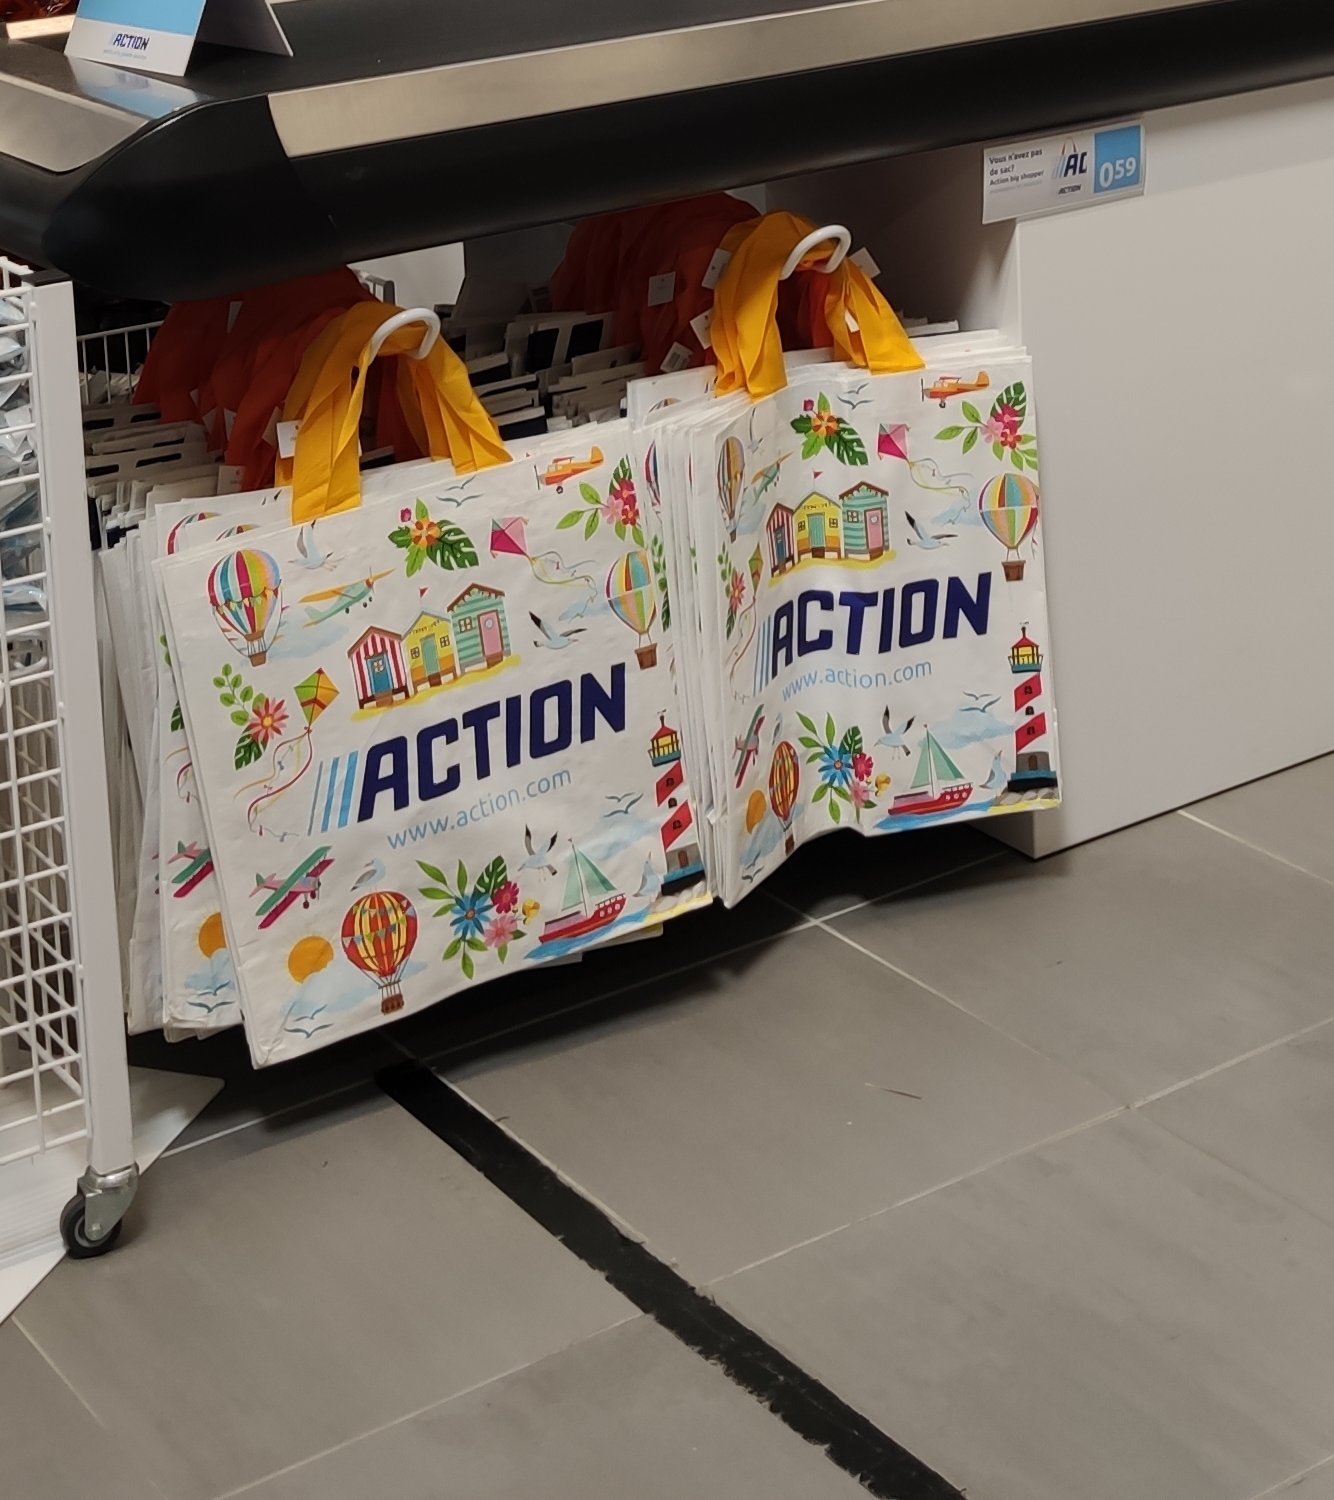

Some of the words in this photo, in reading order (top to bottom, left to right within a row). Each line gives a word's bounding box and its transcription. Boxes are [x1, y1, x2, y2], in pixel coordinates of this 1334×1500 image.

[113, 33, 151, 51] ACTION
[989, 155, 1007, 165] Vous
[1008, 152, 1030, 161] n'avez
[1030, 149, 1043, 158] pas
[989, 167, 1000, 176] de
[1000, 164, 1015, 174] sac?
[989, 177, 1010, 186] Action
[1010, 174, 1020, 182] big
[1020, 170, 1045, 180] shopper
[1099, 157, 1137, 188] 059
[1058, 184, 1082, 195] ACTION
[770, 571, 991, 678] ACTION
[782, 657, 934, 703] www.action.com
[356, 663, 627, 823] ACTION
[385, 767, 573, 850] www.action.com
